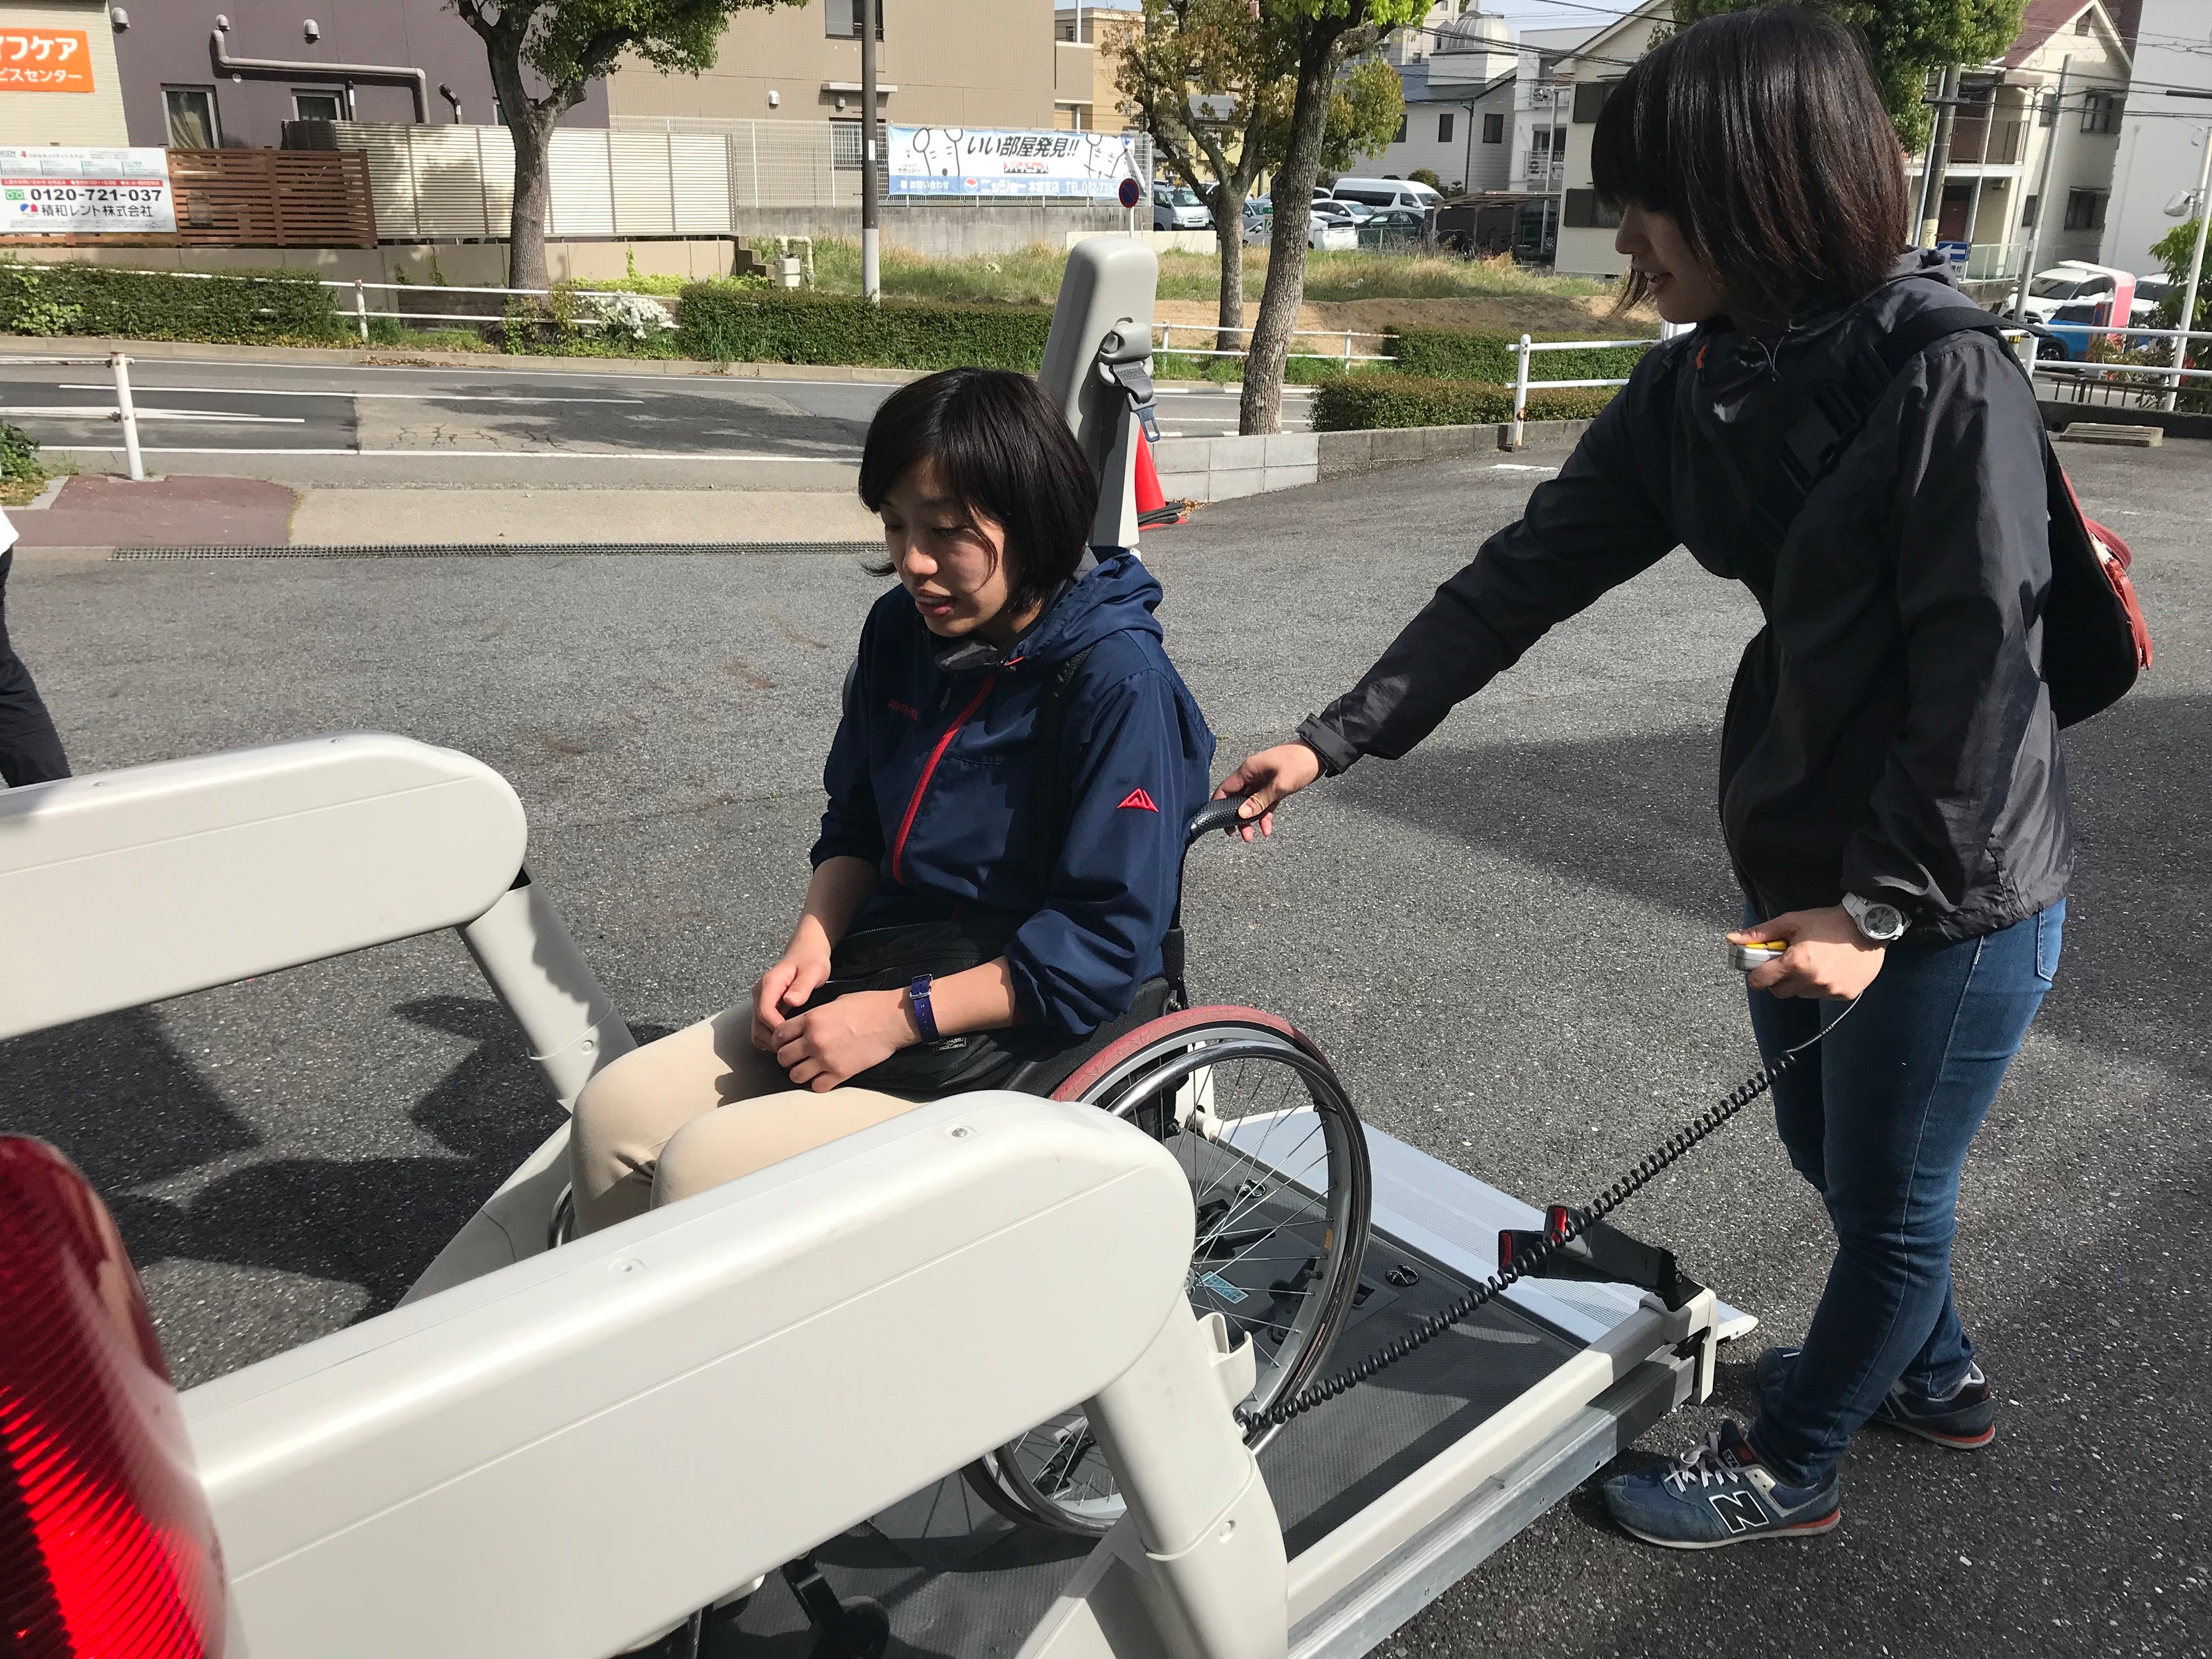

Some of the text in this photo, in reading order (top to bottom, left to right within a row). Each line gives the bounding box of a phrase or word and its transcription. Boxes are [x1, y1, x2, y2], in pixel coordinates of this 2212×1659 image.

[0, 67, 82, 82] ビスセンター
[967, 136, 1080, 158] いい部屋発見!!
[30, 188, 162, 201] 0120-721-037
[909, 180, 949, 189] お問い合わせ
[1065, 180, 1120, 195] TEL.052-775-
[1723, 1450, 1740, 1468] 574
[1708, 1490, 1770, 1534] N
